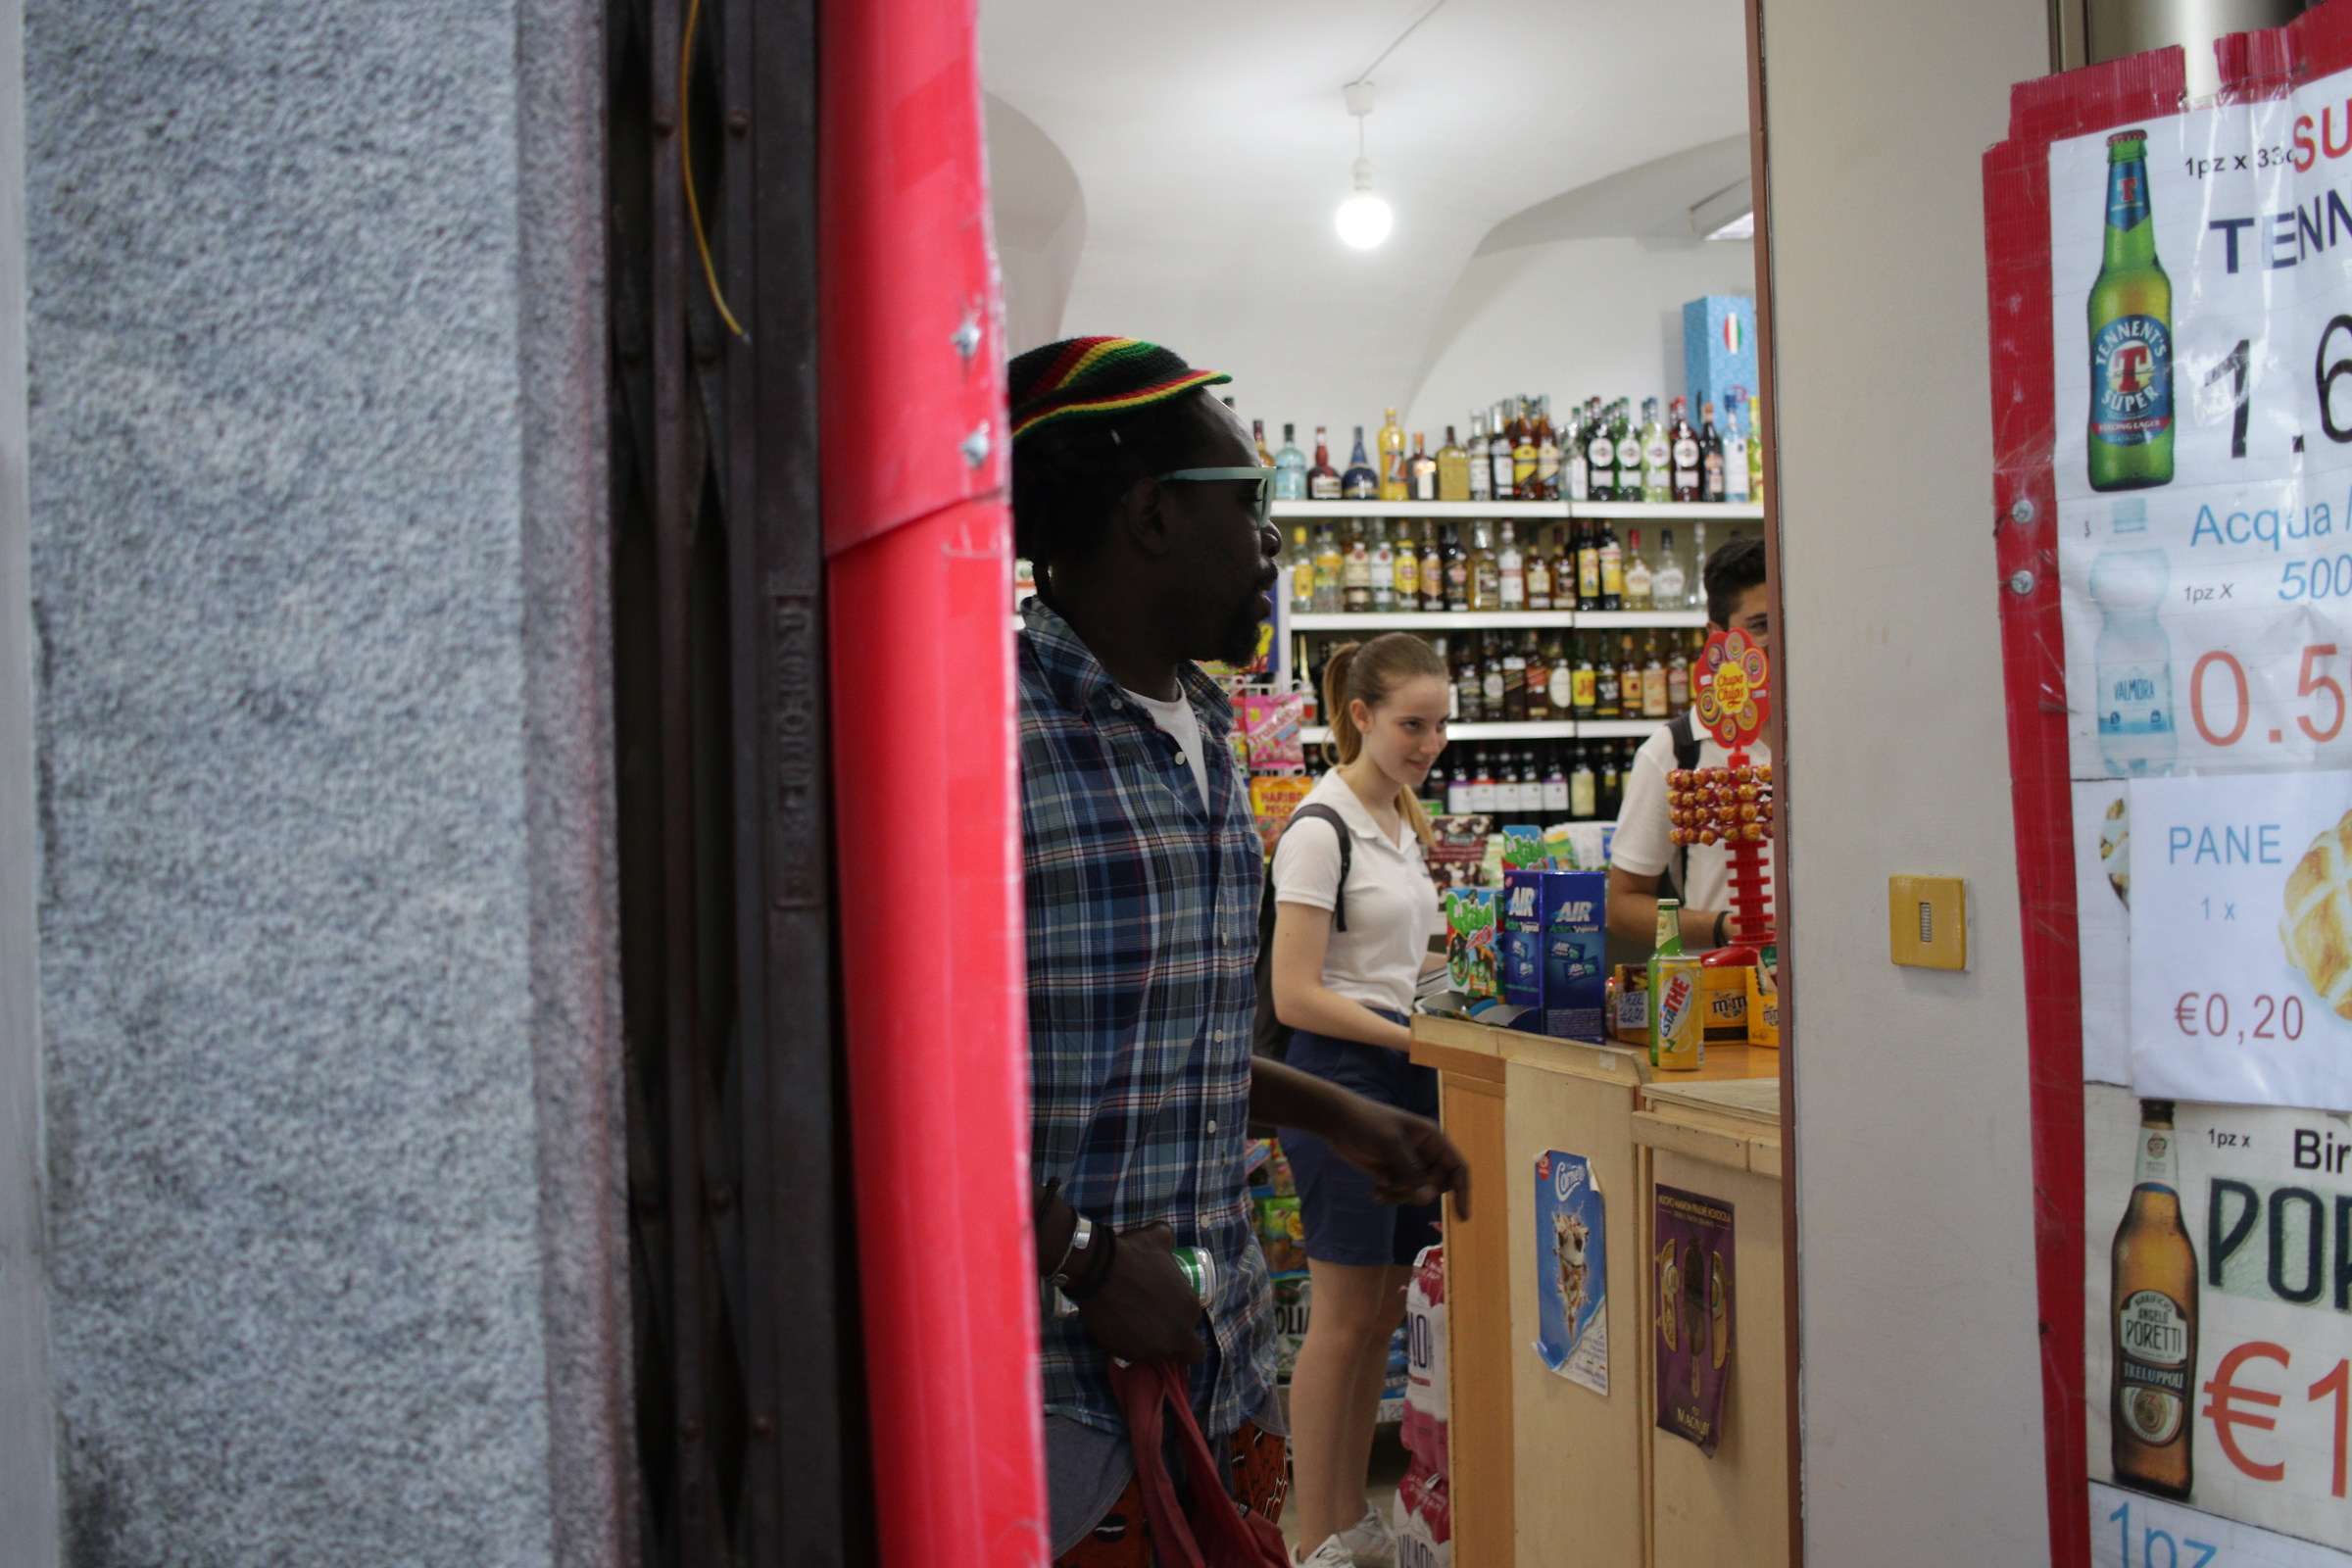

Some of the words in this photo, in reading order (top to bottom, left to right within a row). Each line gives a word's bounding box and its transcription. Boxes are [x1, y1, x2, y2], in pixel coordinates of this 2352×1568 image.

[2185, 156, 2226, 180] 1pz
[2233, 154, 2247, 170] x
[2095, 319, 2167, 366] TENNENT'S
[2101, 385, 2160, 413] SUPER
[2189, 502, 2332, 552] Acqua
[2183, 586, 2214, 605] 1pz
[2169, 825, 2281, 865] PANE
[1508, 887, 1535, 917] AIR
[1555, 902, 1592, 922] AIR
[2201, 898, 2211, 920] 1
[2224, 902, 2235, 920] x
[2175, 992, 2303, 1045] €0,20
[2207, 1129, 2236, 1149] 1pz
[2242, 1136, 2250, 1148] x
[2126, 1319, 2181, 1353] PORETTI
